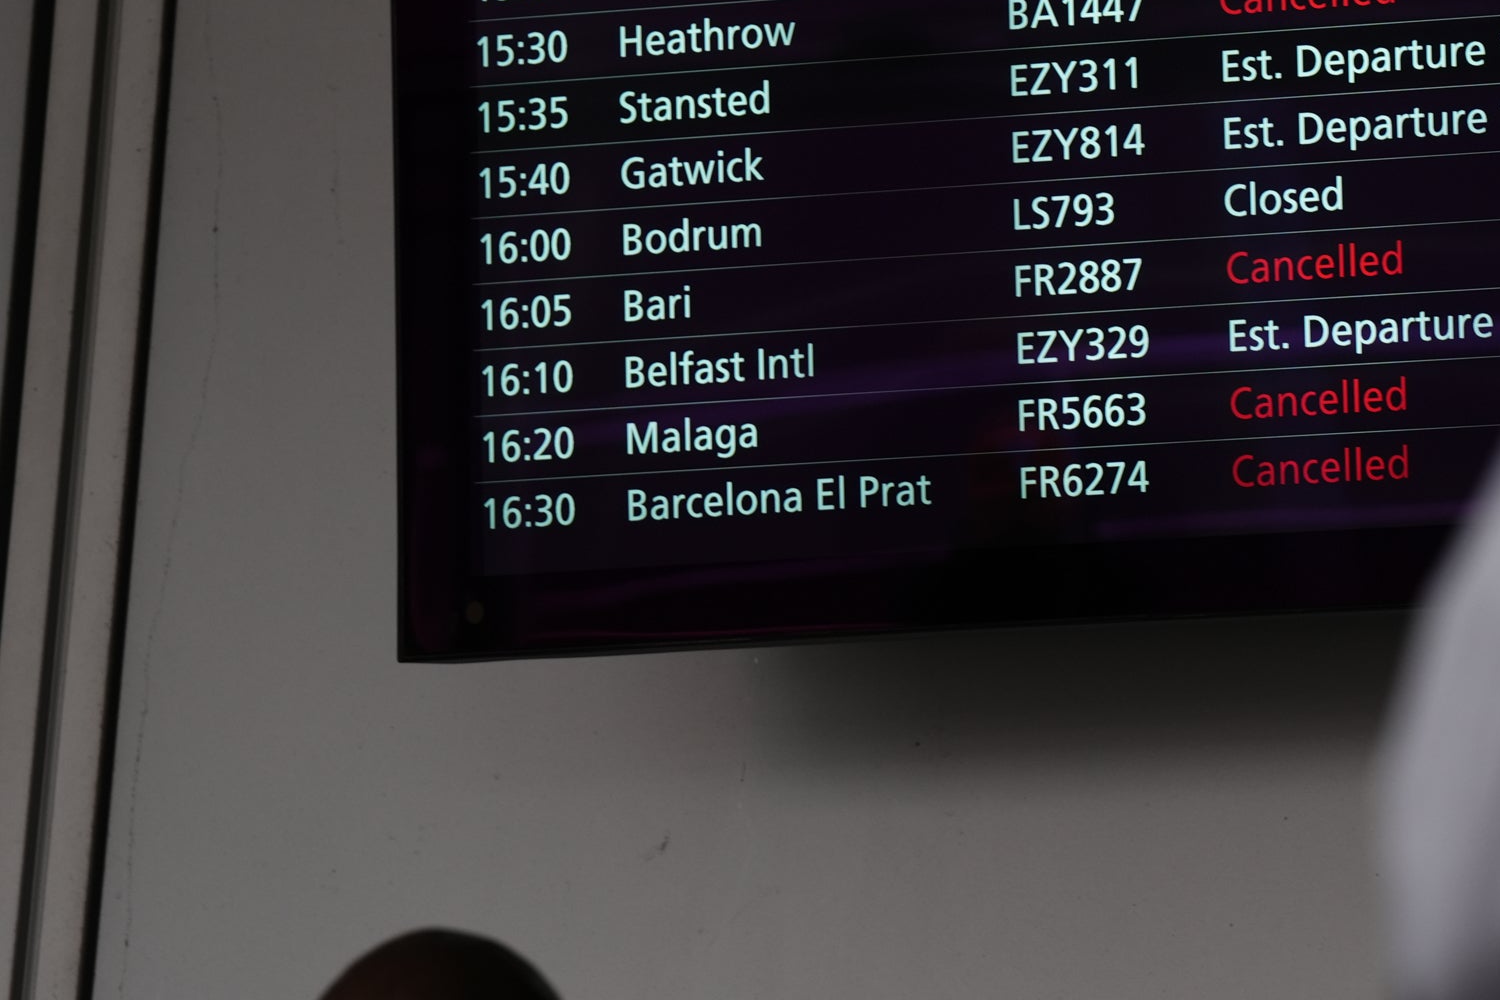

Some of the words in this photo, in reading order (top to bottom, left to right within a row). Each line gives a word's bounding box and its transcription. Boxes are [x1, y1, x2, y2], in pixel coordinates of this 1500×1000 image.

[476, 29, 569, 68] 15:30
[618, 16, 796, 59] Heathrow
[477, 95, 569, 134] 15:35
[618, 78, 771, 125] Stansted
[1009, 55, 1139, 98] EZY311
[1221, 48, 1283, 83] Est.
[1295, 39, 1487, 84] Departure
[478, 161, 571, 200] 15:40
[620, 146, 765, 190] Gatwick
[1011, 122, 1146, 164] EZY814
[1222, 116, 1285, 151] Est.
[1297, 106, 1488, 152] Departure
[479, 226, 572, 266] 16:00
[622, 216, 762, 257] Bodrum
[1012, 191, 1115, 231] LS793
[1223, 174, 1344, 218] Closed
[480, 293, 572, 332] 16:05
[623, 284, 692, 323] Bari
[1014, 257, 1143, 298] FR2887
[1226, 239, 1404, 285] Cancelled
[481, 359, 574, 398] 16:10
[624, 349, 746, 389] Belfast
[757, 342, 815, 381] Intl
[1016, 324, 1150, 365] EZY329
[1228, 318, 1290, 353] Est.
[1303, 310, 1494, 355] Departure
[482, 425, 575, 464] 16:20
[625, 416, 759, 459] Malaga
[1017, 391, 1147, 432] FR5663
[1229, 375, 1408, 420] Cancelled
[483, 492, 576, 530] 16:30
[627, 480, 803, 522] Barcelona
[816, 474, 846, 511] El
[859, 474, 932, 509] Prat
[1019, 459, 1150, 500] FR6274
[1232, 444, 1409, 488] Cancelled
